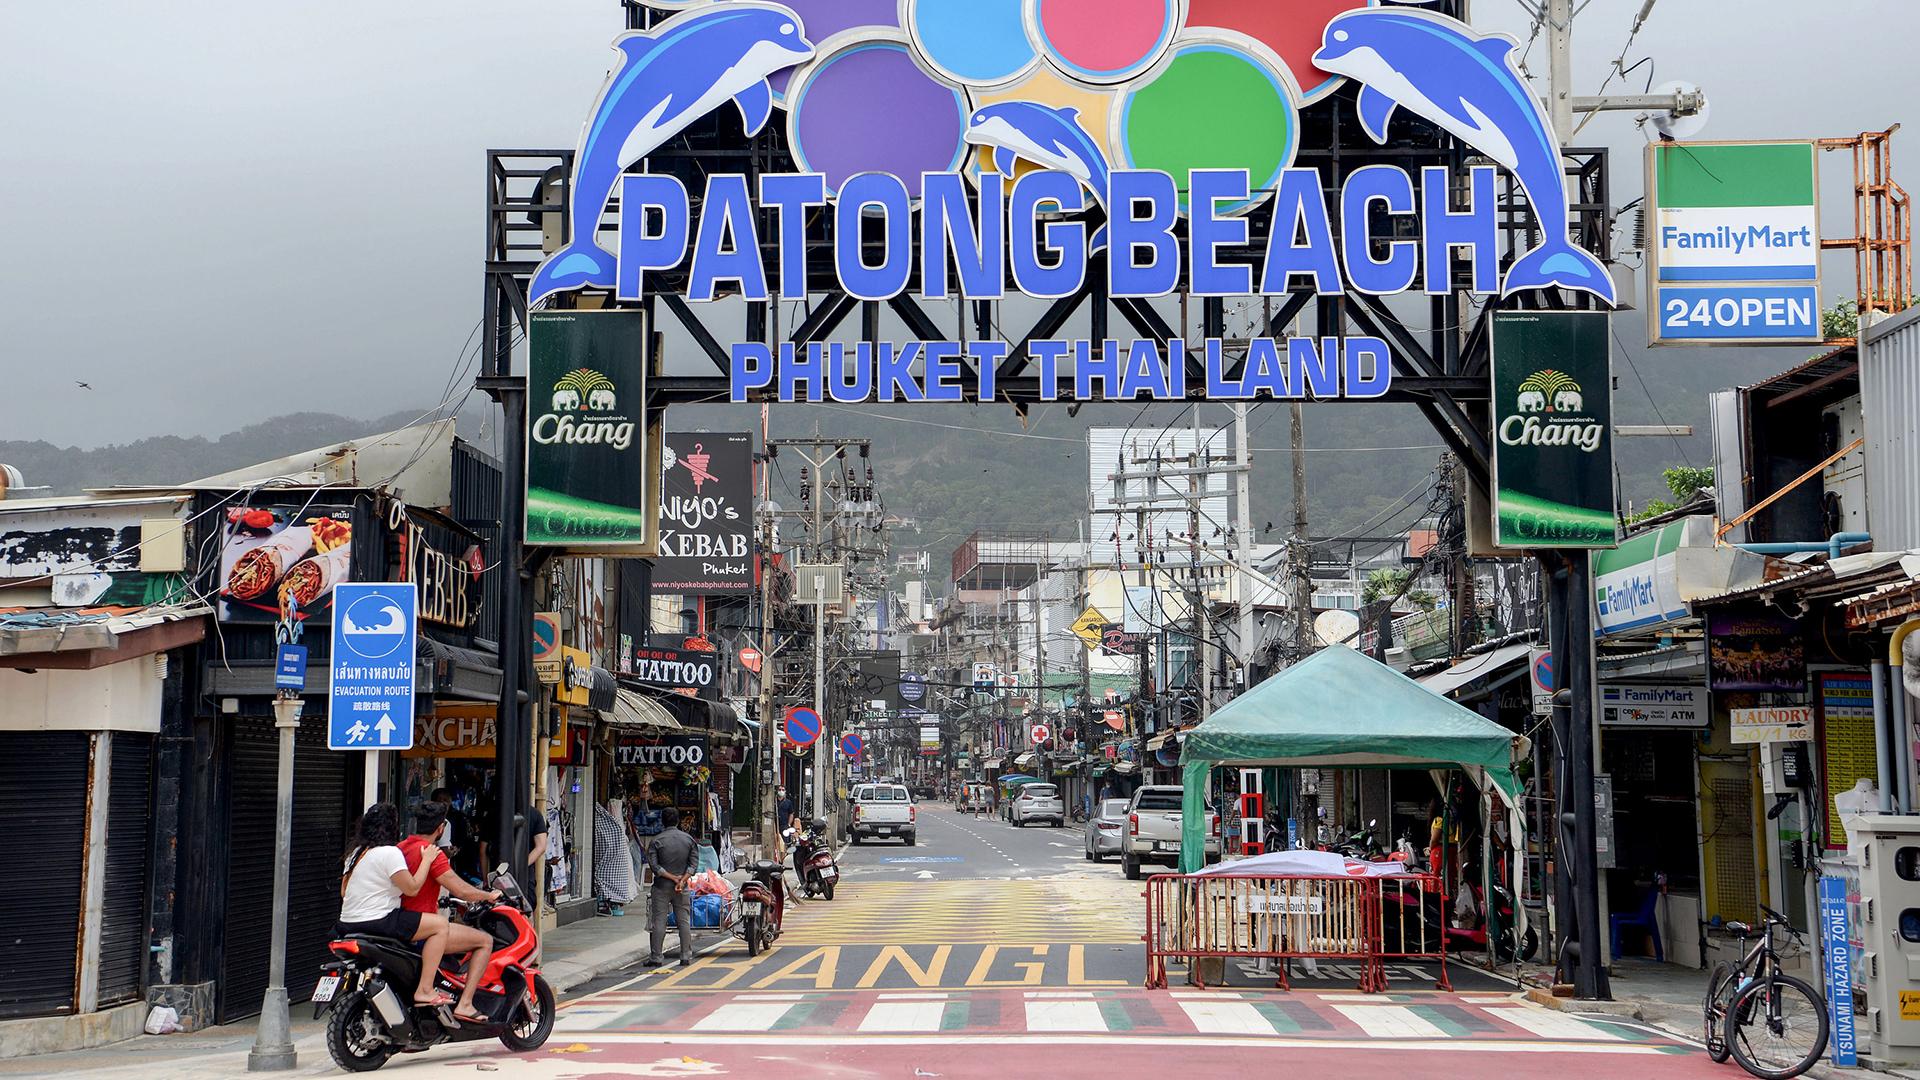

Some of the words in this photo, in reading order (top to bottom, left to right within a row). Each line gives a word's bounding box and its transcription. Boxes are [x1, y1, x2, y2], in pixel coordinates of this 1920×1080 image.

[616, 171, 1087, 302] PATONG
[1107, 165, 1500, 298] BEACH
[1662, 225, 1811, 254] FamilyMart
[1665, 297, 1811, 327] 24OPEN
[730, 341, 1007, 403] PHUKET
[532, 413, 636, 450] Chang
[1499, 414, 1604, 452] Chang
[658, 529, 748, 557] KEBAB
[408, 523, 468, 628] KEBAB
[702, 562, 748, 575] Phuket
[652, 581, 749, 589] www.niyoskebabphuket.com
[1608, 576, 1654, 616] FamilyMart
[335, 661, 411, 680] เส้นทางหลบภัย
[637, 658, 712, 686] TATTOO
[335, 686, 381, 696] EVACUATION
[384, 686, 410, 696] ROUTE
[1625, 689, 1693, 702] FamilyMart
[1671, 711, 1695, 720] ATM
[1735, 709, 1811, 724] LAUNDRY
[619, 745, 703, 764] TATTOO
[1831, 909, 1846, 942] ZONE
[1833, 947, 1850, 996] HAZARD
[1836, 1002, 1854, 1056] TSUNAMI
